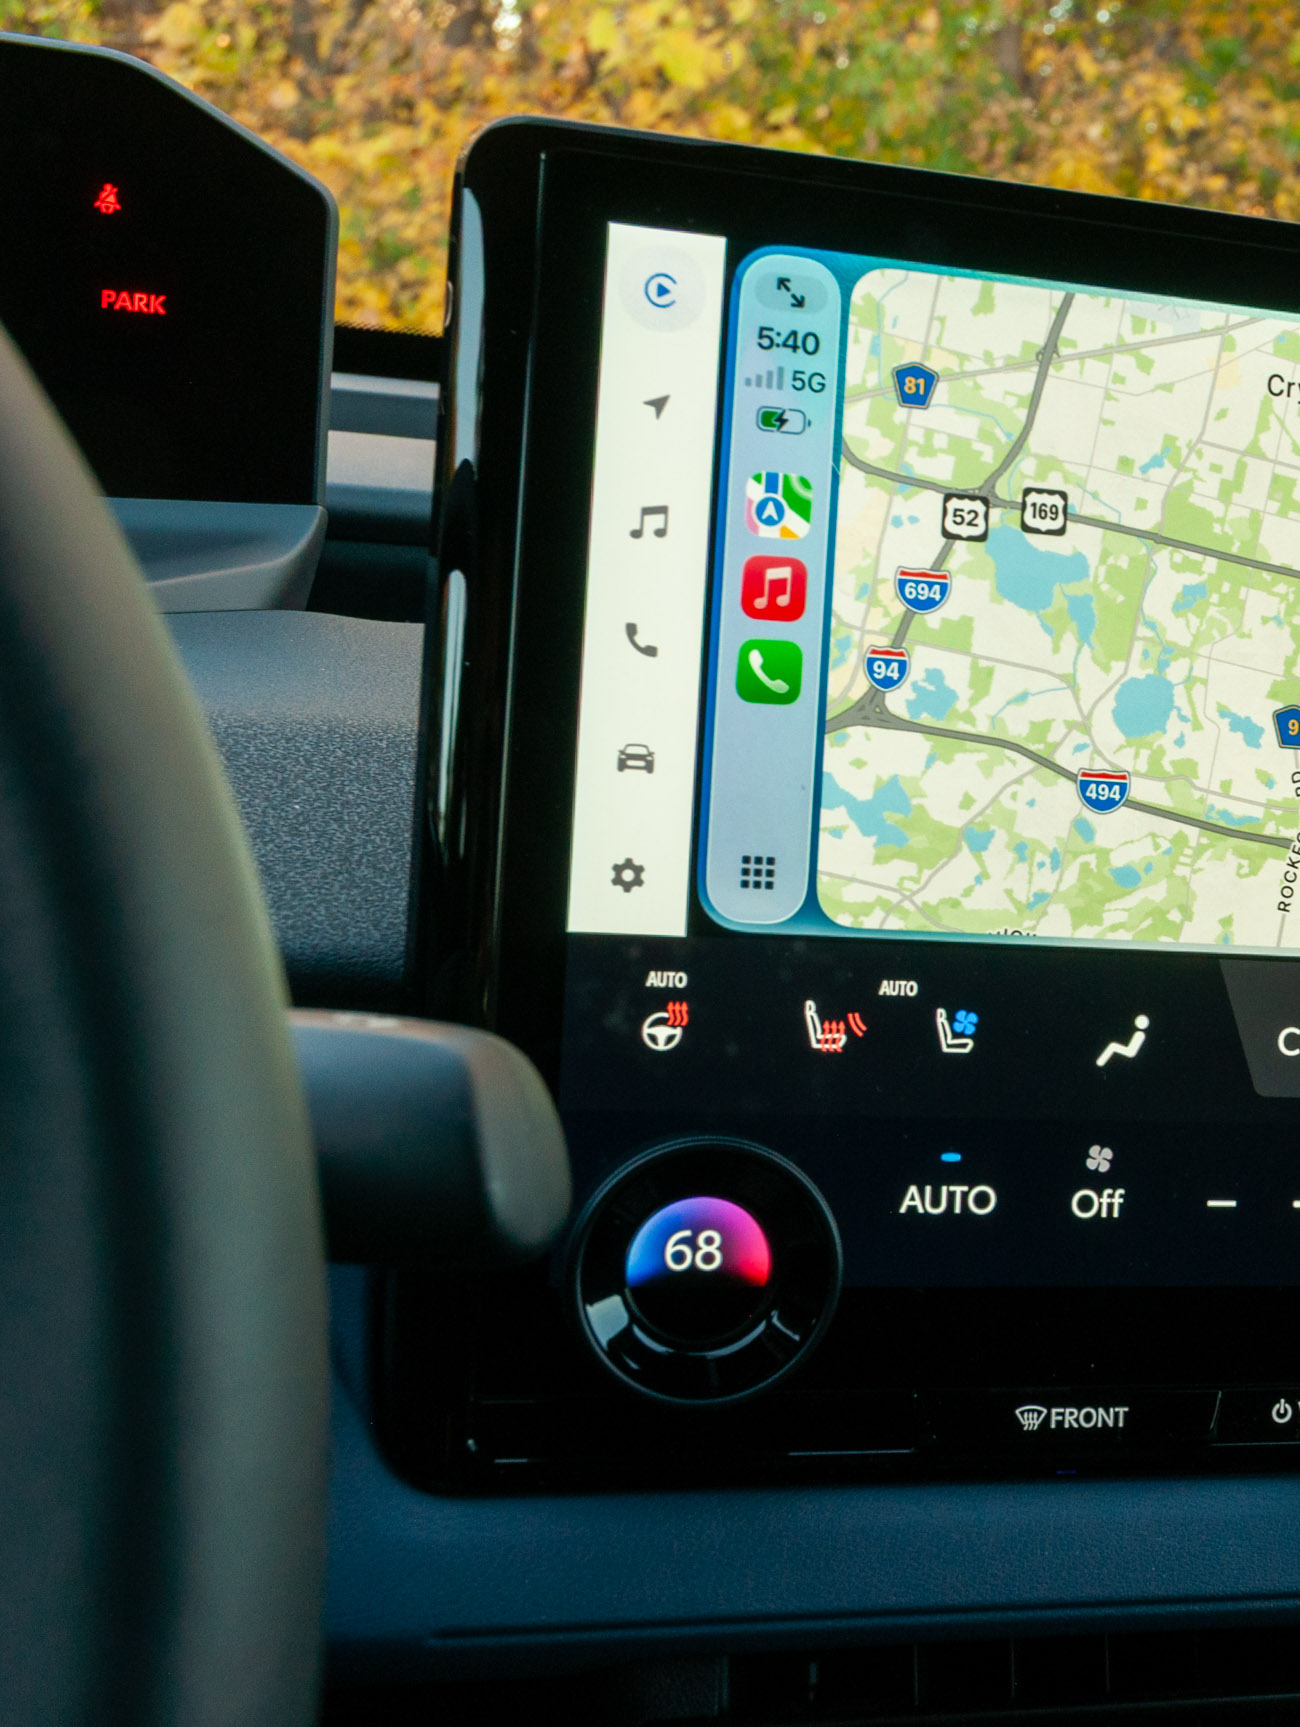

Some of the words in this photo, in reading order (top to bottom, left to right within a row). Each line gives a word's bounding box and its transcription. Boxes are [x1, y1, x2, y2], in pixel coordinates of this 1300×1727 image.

[101, 289, 167, 315] PARK
[757, 326, 821, 355] 5:40
[791, 370, 826, 393] 5G
[904, 376, 926, 395] 81
[952, 509, 979, 528] 52
[1030, 501, 1059, 521] 169
[904, 582, 941, 602] 694
[873, 661, 900, 680] 94
[1288, 719, 1299, 735] 9
[1086, 783, 1121, 802] 494
[646, 971, 688, 988] AUTO
[879, 980, 919, 997] AUTO
[900, 1185, 997, 1215] AUTO
[1071, 1188, 1125, 1219] Off
[664, 1230, 723, 1271] 68
[1050, 1407, 1129, 1429] FRONT
